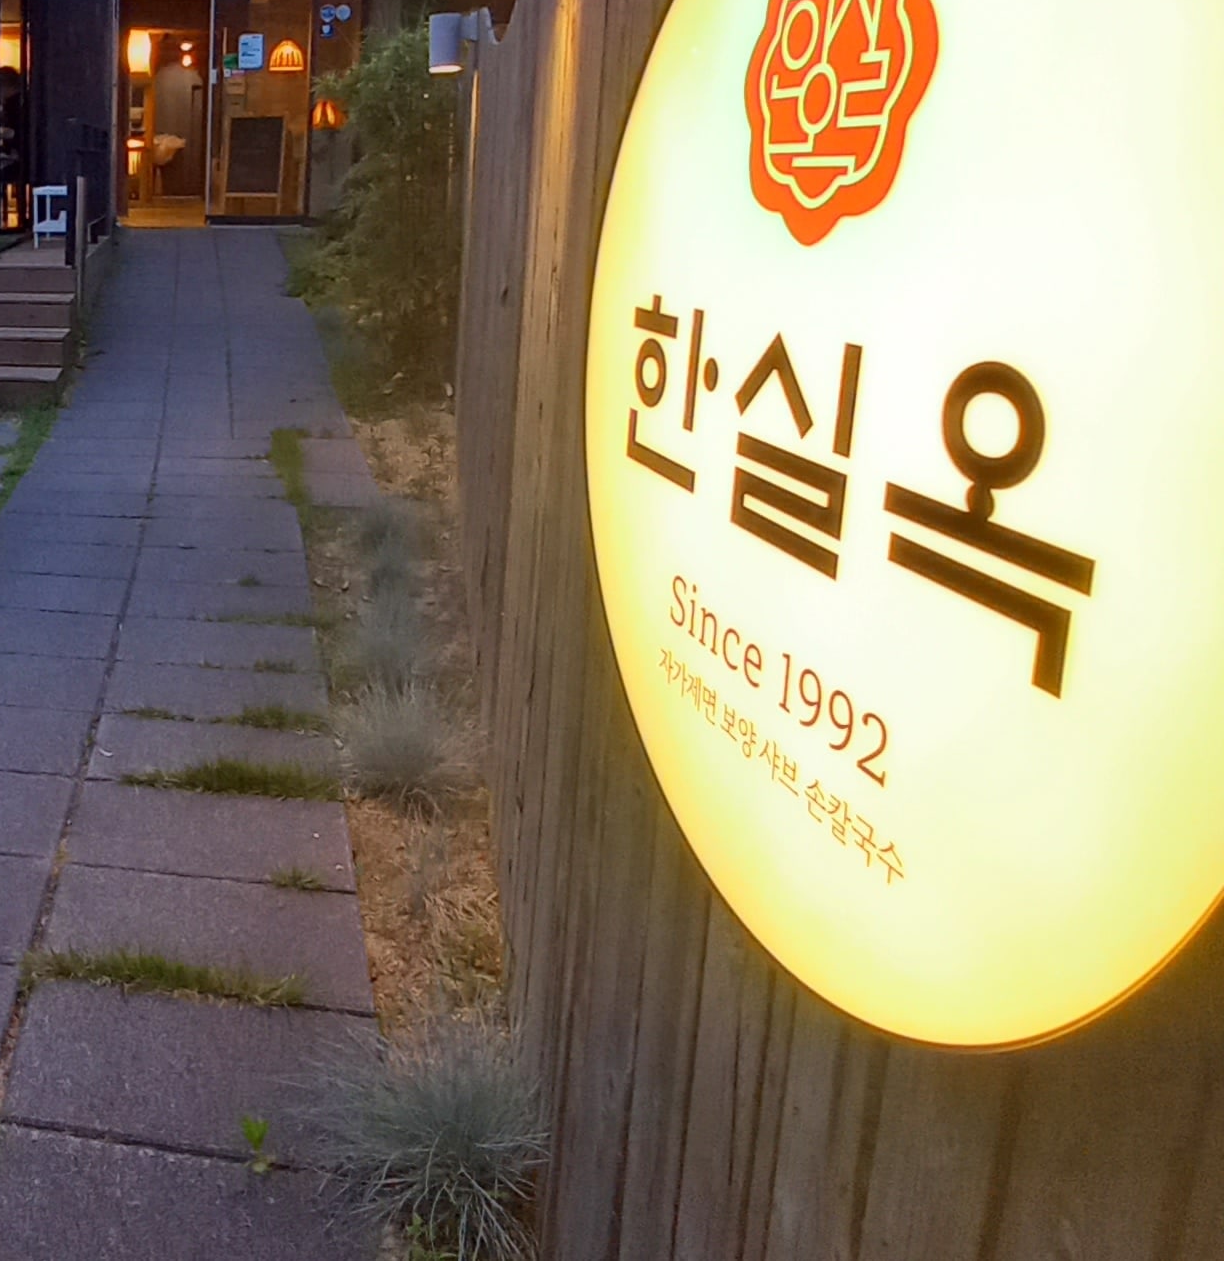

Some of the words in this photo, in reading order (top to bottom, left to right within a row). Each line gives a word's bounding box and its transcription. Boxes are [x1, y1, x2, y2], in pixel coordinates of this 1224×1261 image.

[626, 294, 1096, 699] 한실옥
[659, 648, 717, 725] 자가제면
[720, 703, 757, 758] 보양
[758, 739, 800, 797] 샤브
[804, 778, 905, 884] 손칼국수
[670, 575, 762, 688] Since
[778, 652, 888, 788] 1992
